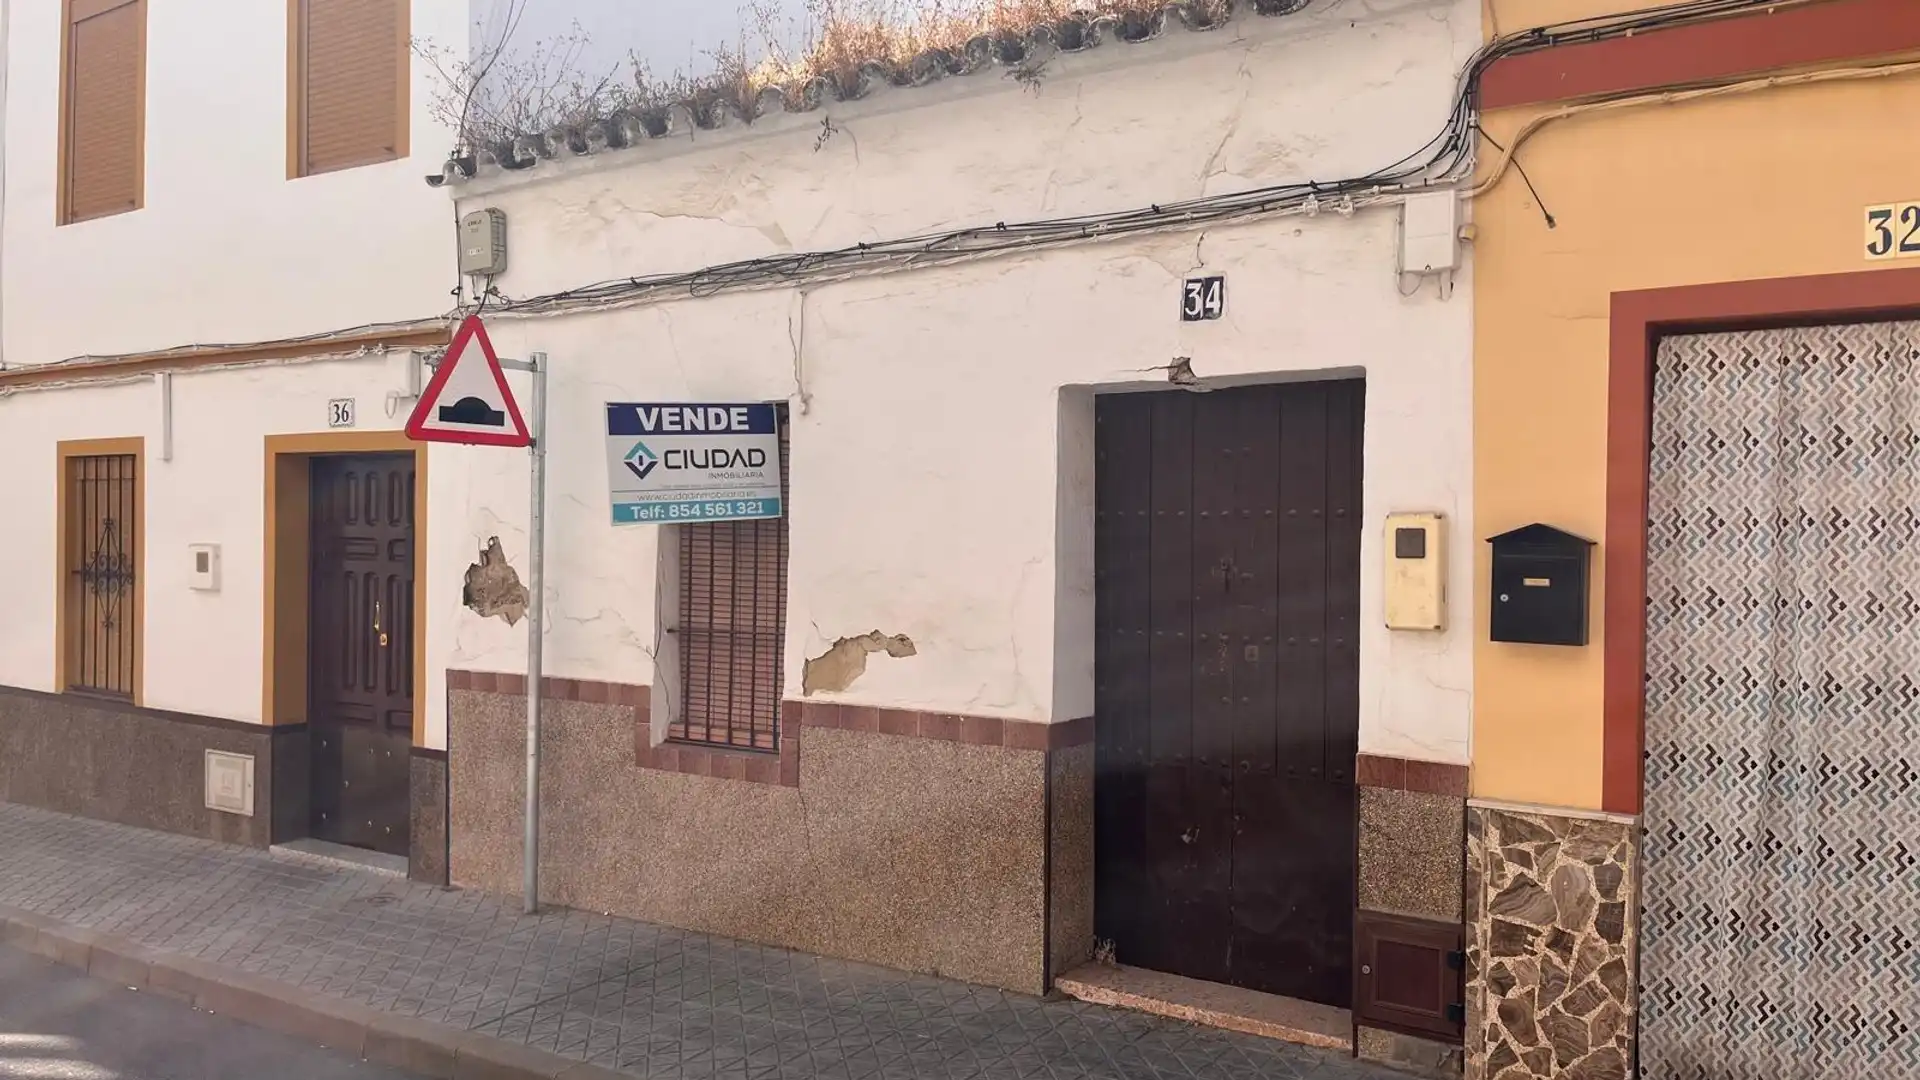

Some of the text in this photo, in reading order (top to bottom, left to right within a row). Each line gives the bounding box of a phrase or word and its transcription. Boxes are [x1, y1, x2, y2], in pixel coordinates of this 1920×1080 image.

[1867, 205, 1920, 256] 32
[1184, 280, 1222, 316] 34
[332, 402, 350, 424] 36
[635, 406, 750, 431] VENDE
[663, 447, 767, 470] CIUDAD
[630, 501, 765, 520] Telf: 854 561 321
